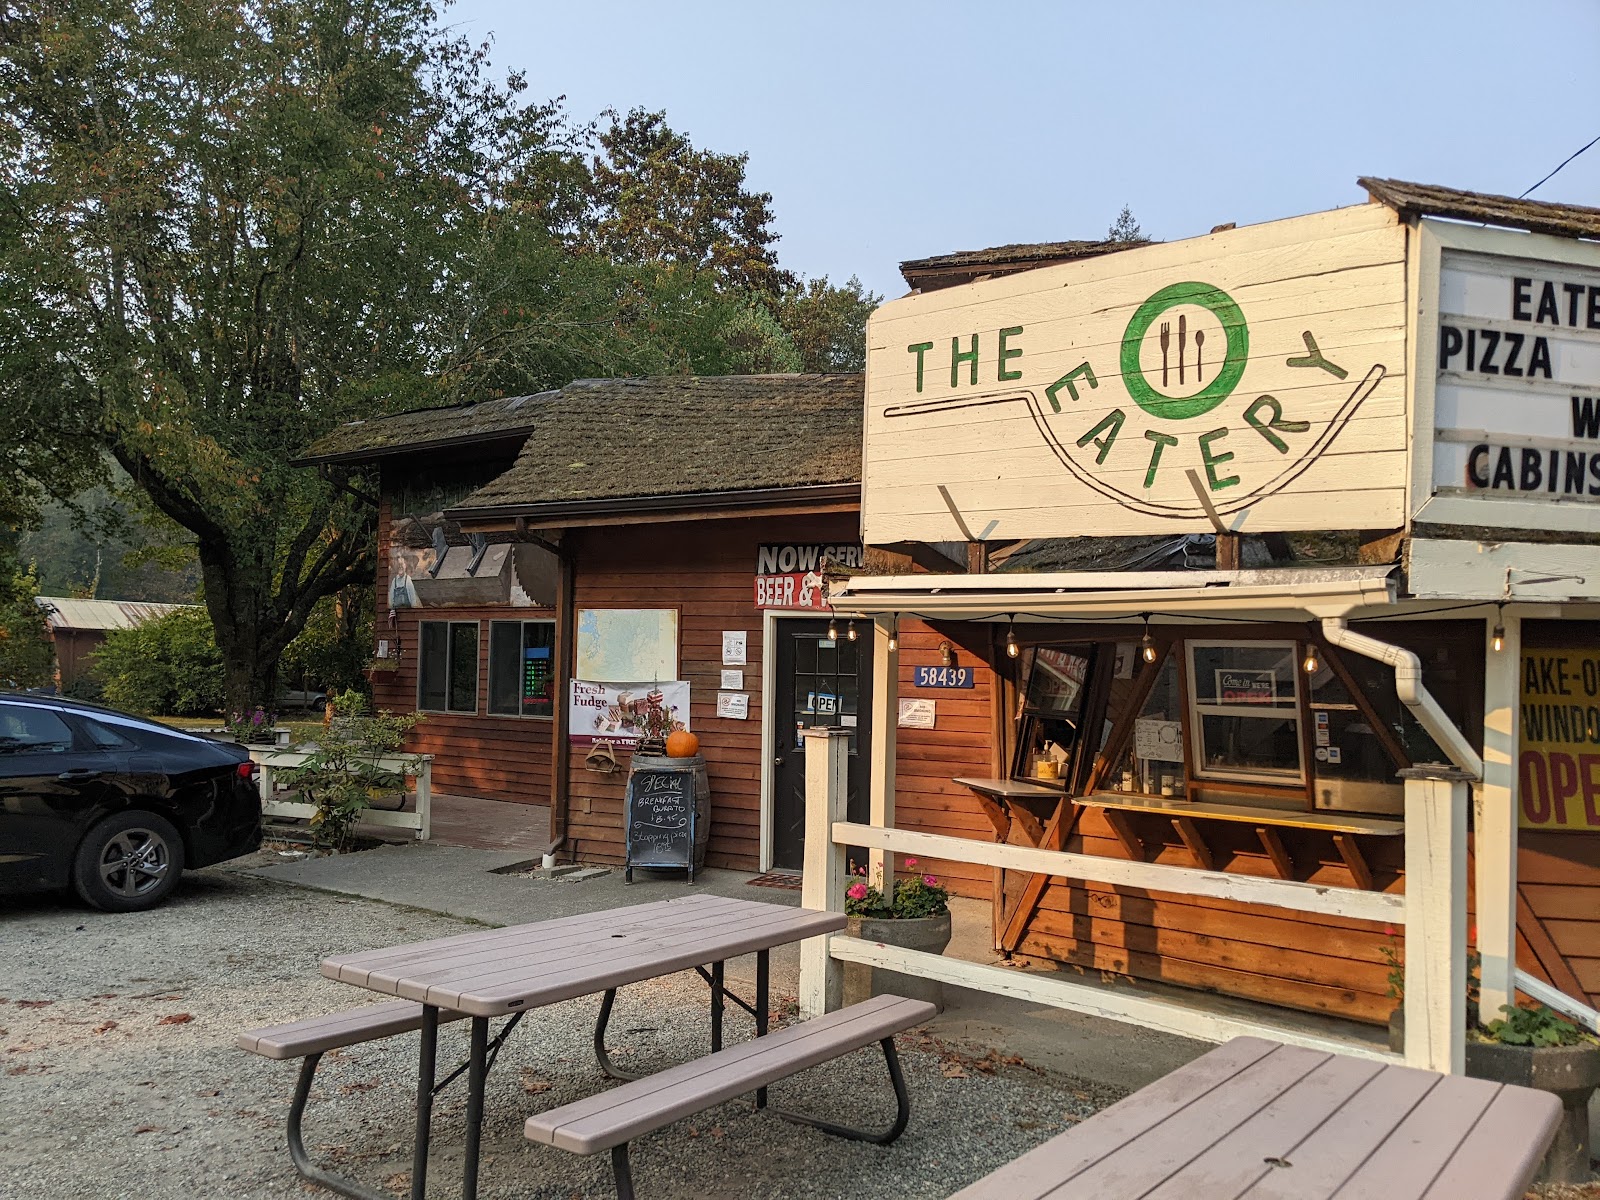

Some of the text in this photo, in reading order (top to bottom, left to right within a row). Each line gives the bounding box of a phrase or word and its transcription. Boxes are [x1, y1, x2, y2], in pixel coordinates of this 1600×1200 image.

[908, 326, 1024, 393] THE
[1439, 326, 1553, 378] PIZZA
[1044, 330, 1349, 492] EATERY
[1468, 444, 1600, 496] CABINS
[758, 546, 820, 573] NOW
[757, 576, 795, 606] BEER
[574, 682, 606, 694] Fresh
[920, 667, 966, 686] 58439
[1223, 674, 1242, 688] Come
[574, 695, 608, 710] Fudge
